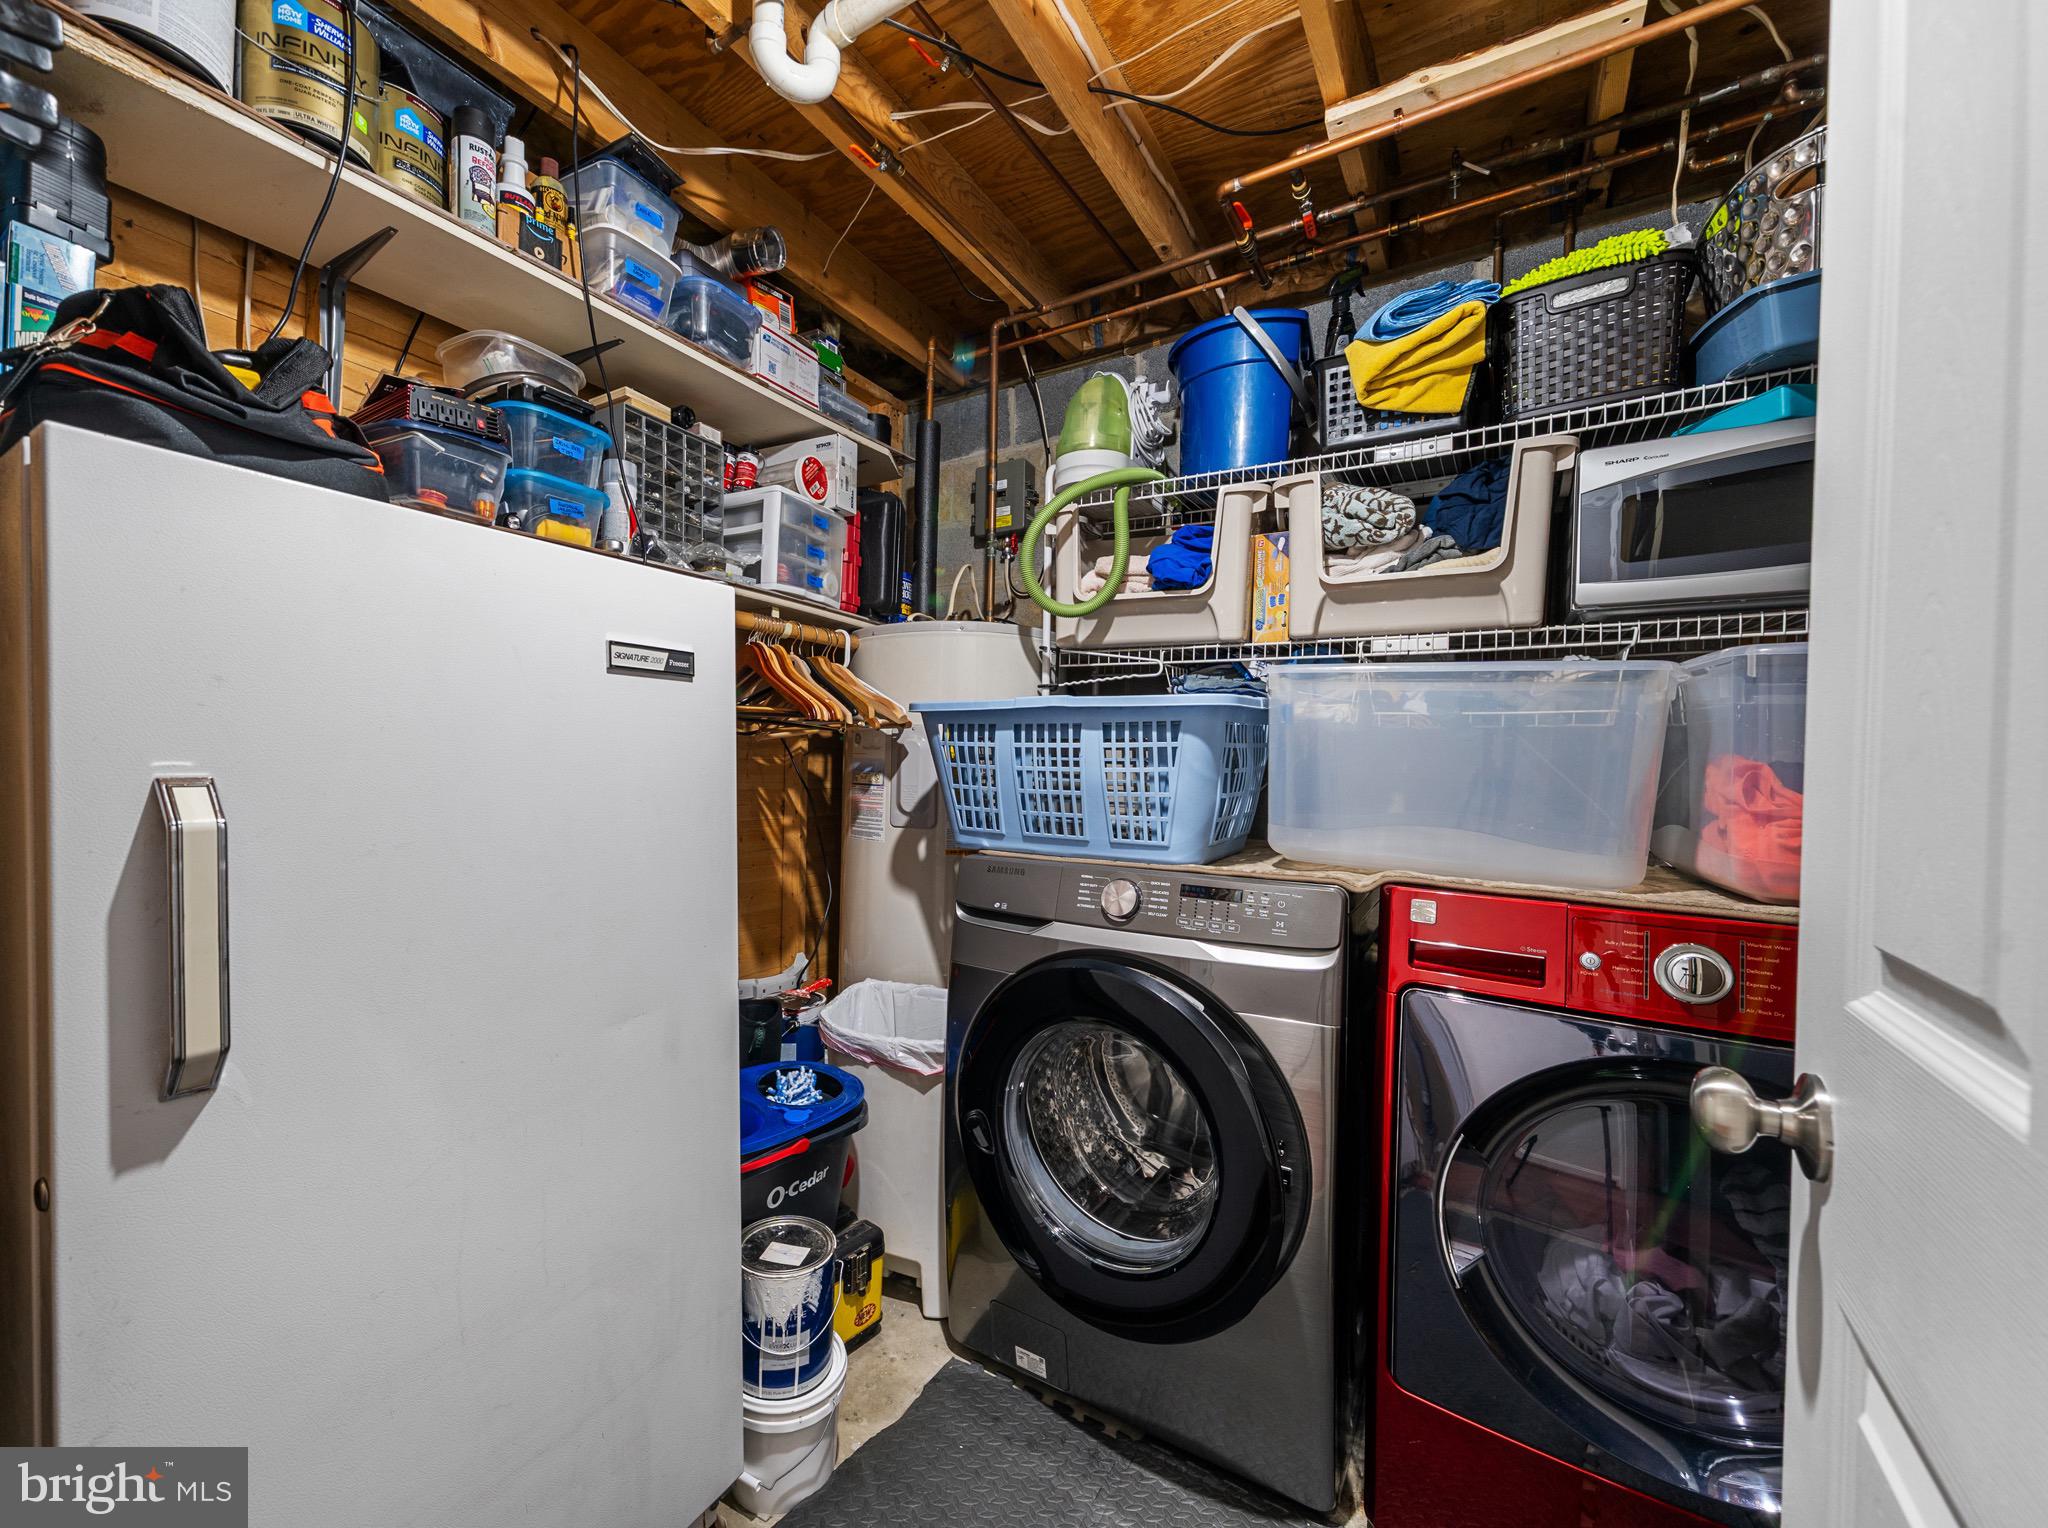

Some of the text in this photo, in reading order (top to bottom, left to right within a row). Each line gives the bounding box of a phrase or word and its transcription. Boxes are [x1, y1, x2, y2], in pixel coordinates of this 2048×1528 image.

[278, 7, 302, 17] HGTV
[278, 14, 302, 25] HOME
[295, 112, 315, 122] ULTRA
[317, 119, 335, 131] WHITE
[526, 215, 555, 236] prime
[1605, 456, 1640, 466] SHARP
[613, 651, 650, 663] SIGNATURE
[650, 656, 664, 665] 2000
[986, 865, 1026, 876] SAMSUNG
[1526, 946, 1548, 954] Steam
[1746, 942, 1772, 950] Workout
[1611, 965, 1630, 973] Heavy
[1746, 968, 1774, 976] Delicates
[1746, 981, 1769, 990] Express
